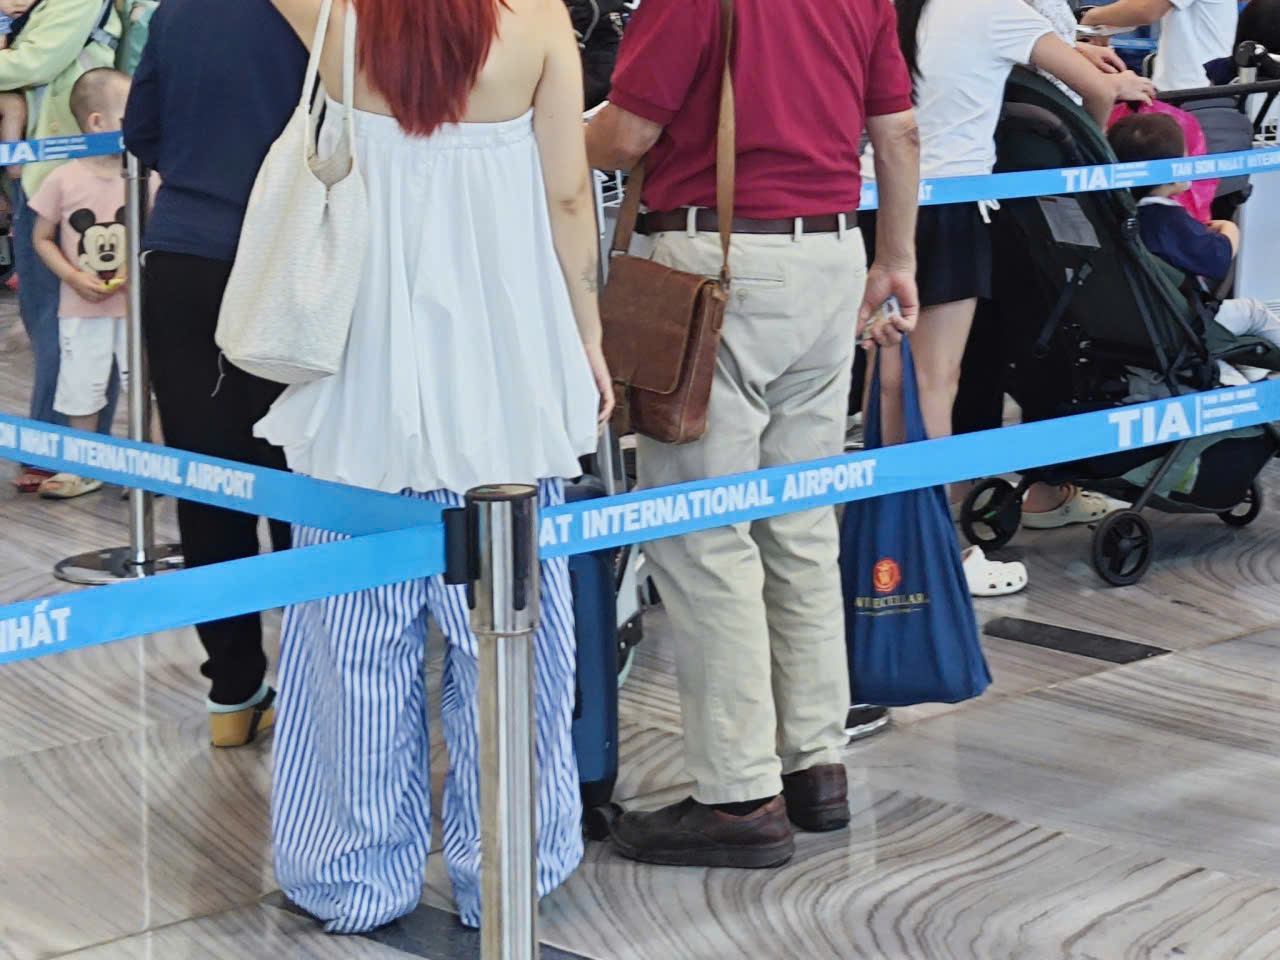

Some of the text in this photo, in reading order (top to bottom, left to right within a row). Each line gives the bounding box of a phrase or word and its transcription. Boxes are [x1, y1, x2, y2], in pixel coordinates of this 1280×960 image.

[0, 142, 37, 163] IA
[1171, 162, 1193, 177] TAN
[1194, 159, 1216, 174] SON
[1217, 156, 1245, 171] NHAT
[1060, 166, 1108, 192] TIA
[1107, 401, 1192, 448] TIA
[20, 426, 59, 458] NHAT
[62, 436, 182, 484] INTERNATIONAL
[185, 461, 256, 499] AIRPORT
[539, 459, 877, 546] AT INTERNATIONAL AIRPORT
